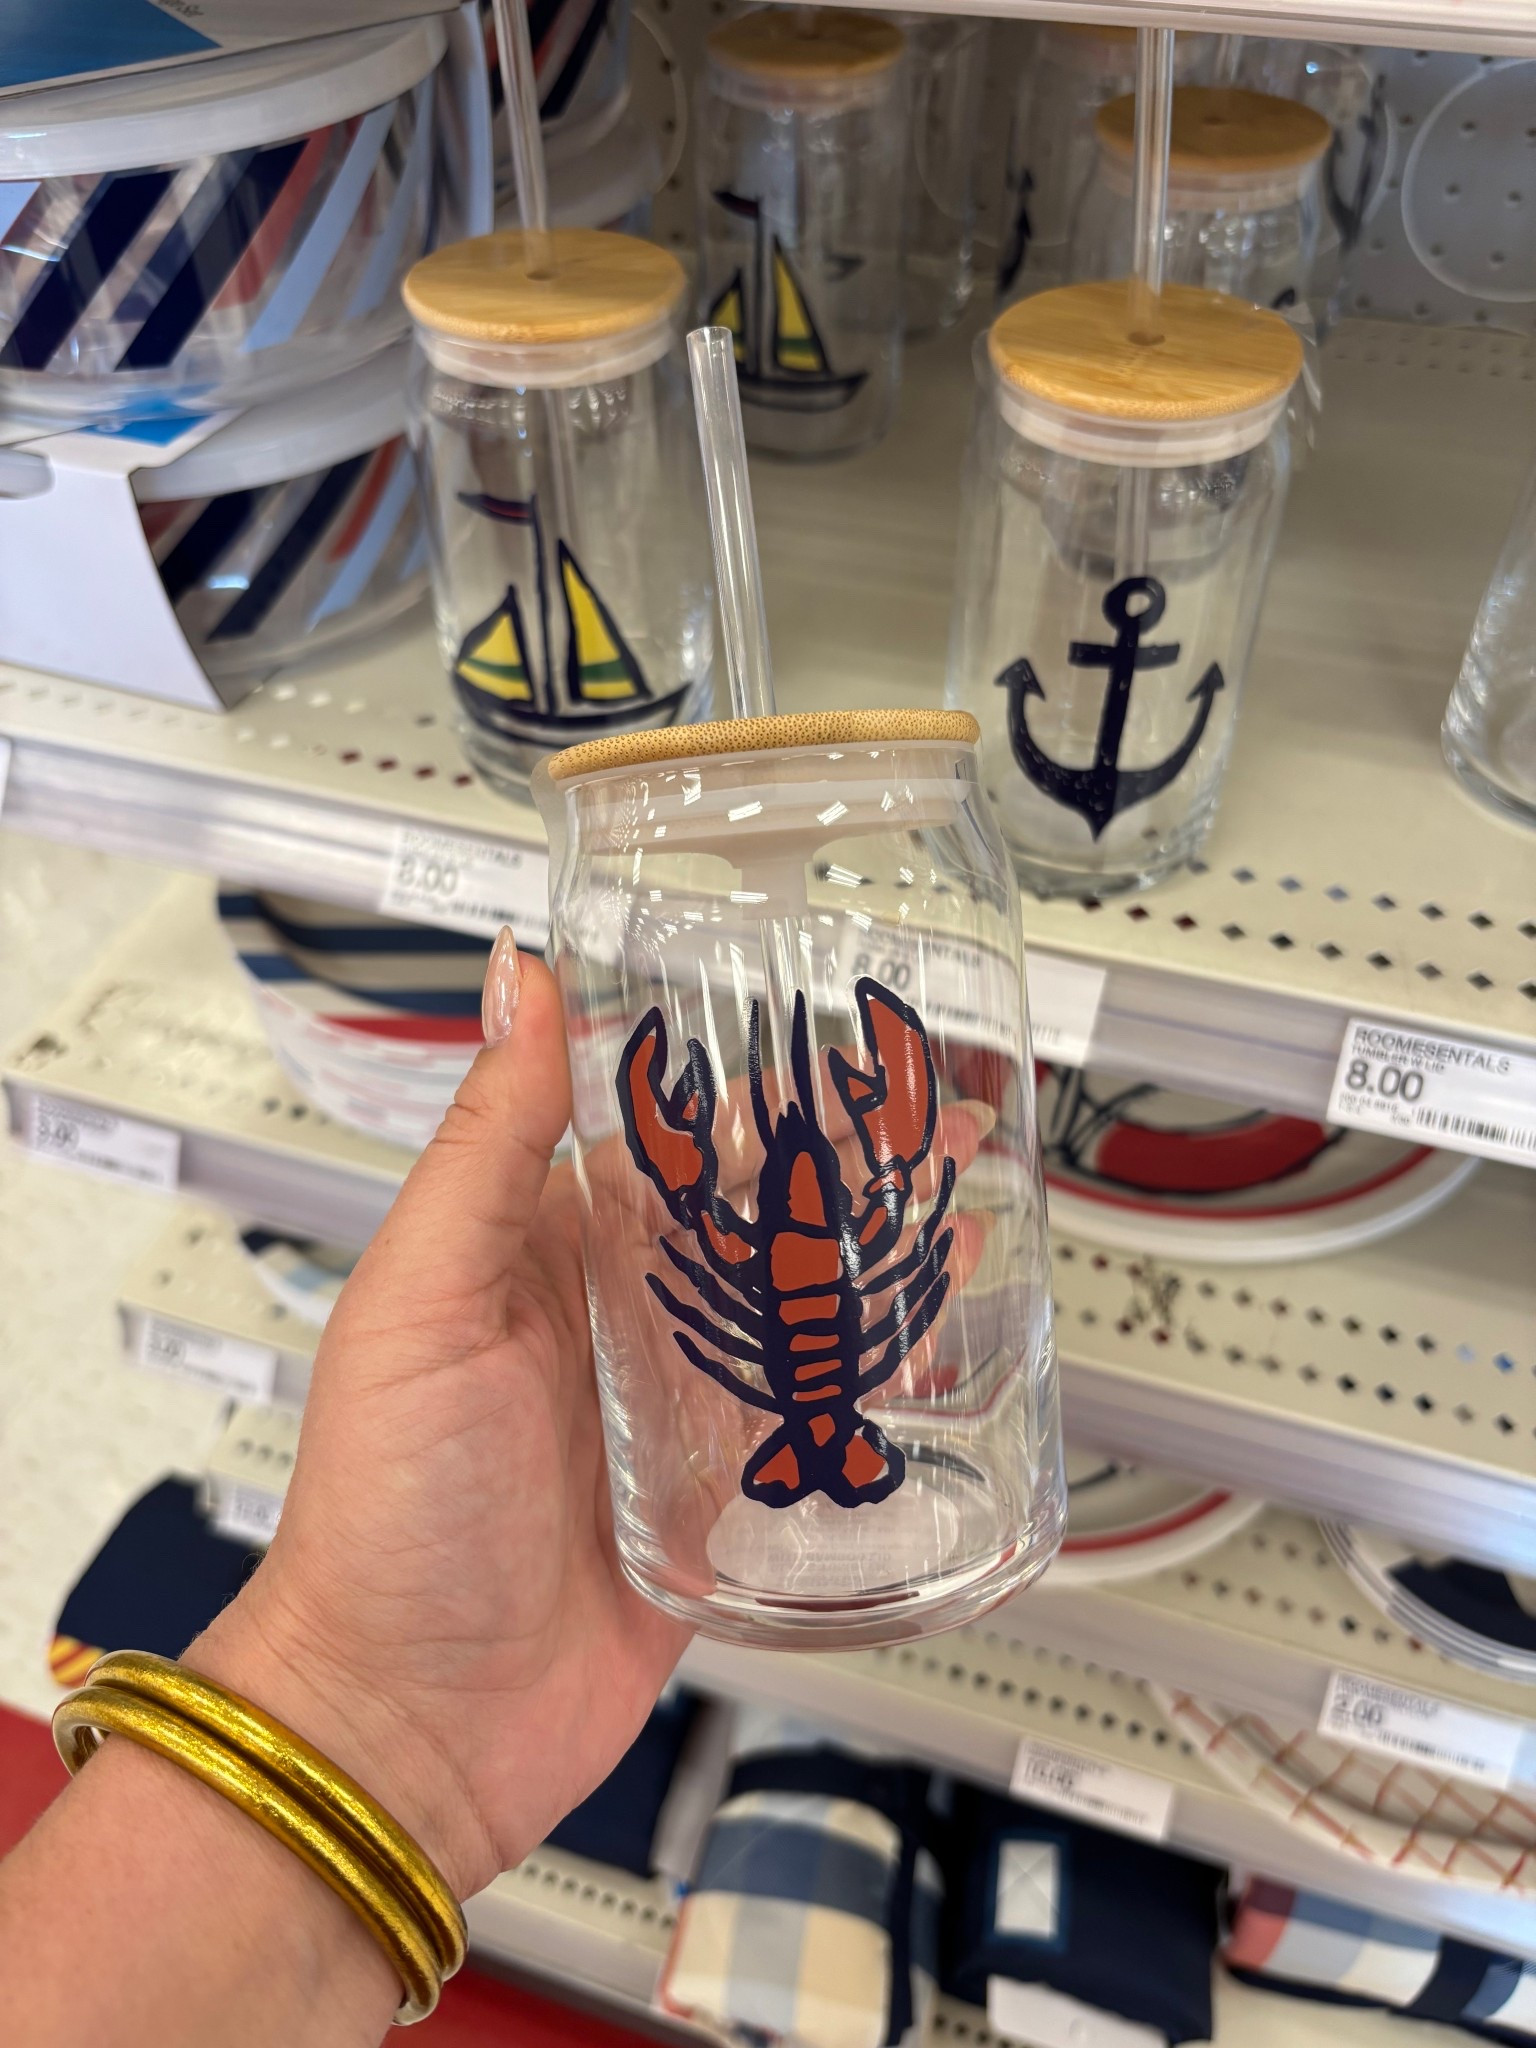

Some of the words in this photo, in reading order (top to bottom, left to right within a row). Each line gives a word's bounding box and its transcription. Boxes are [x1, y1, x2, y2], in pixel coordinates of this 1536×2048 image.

[397, 855, 458, 896] 8.00
[852, 952, 910, 991] 800
[1354, 1026, 1510, 1073] ROOMESENTALS
[1345, 1058, 1424, 1102] 8.00
